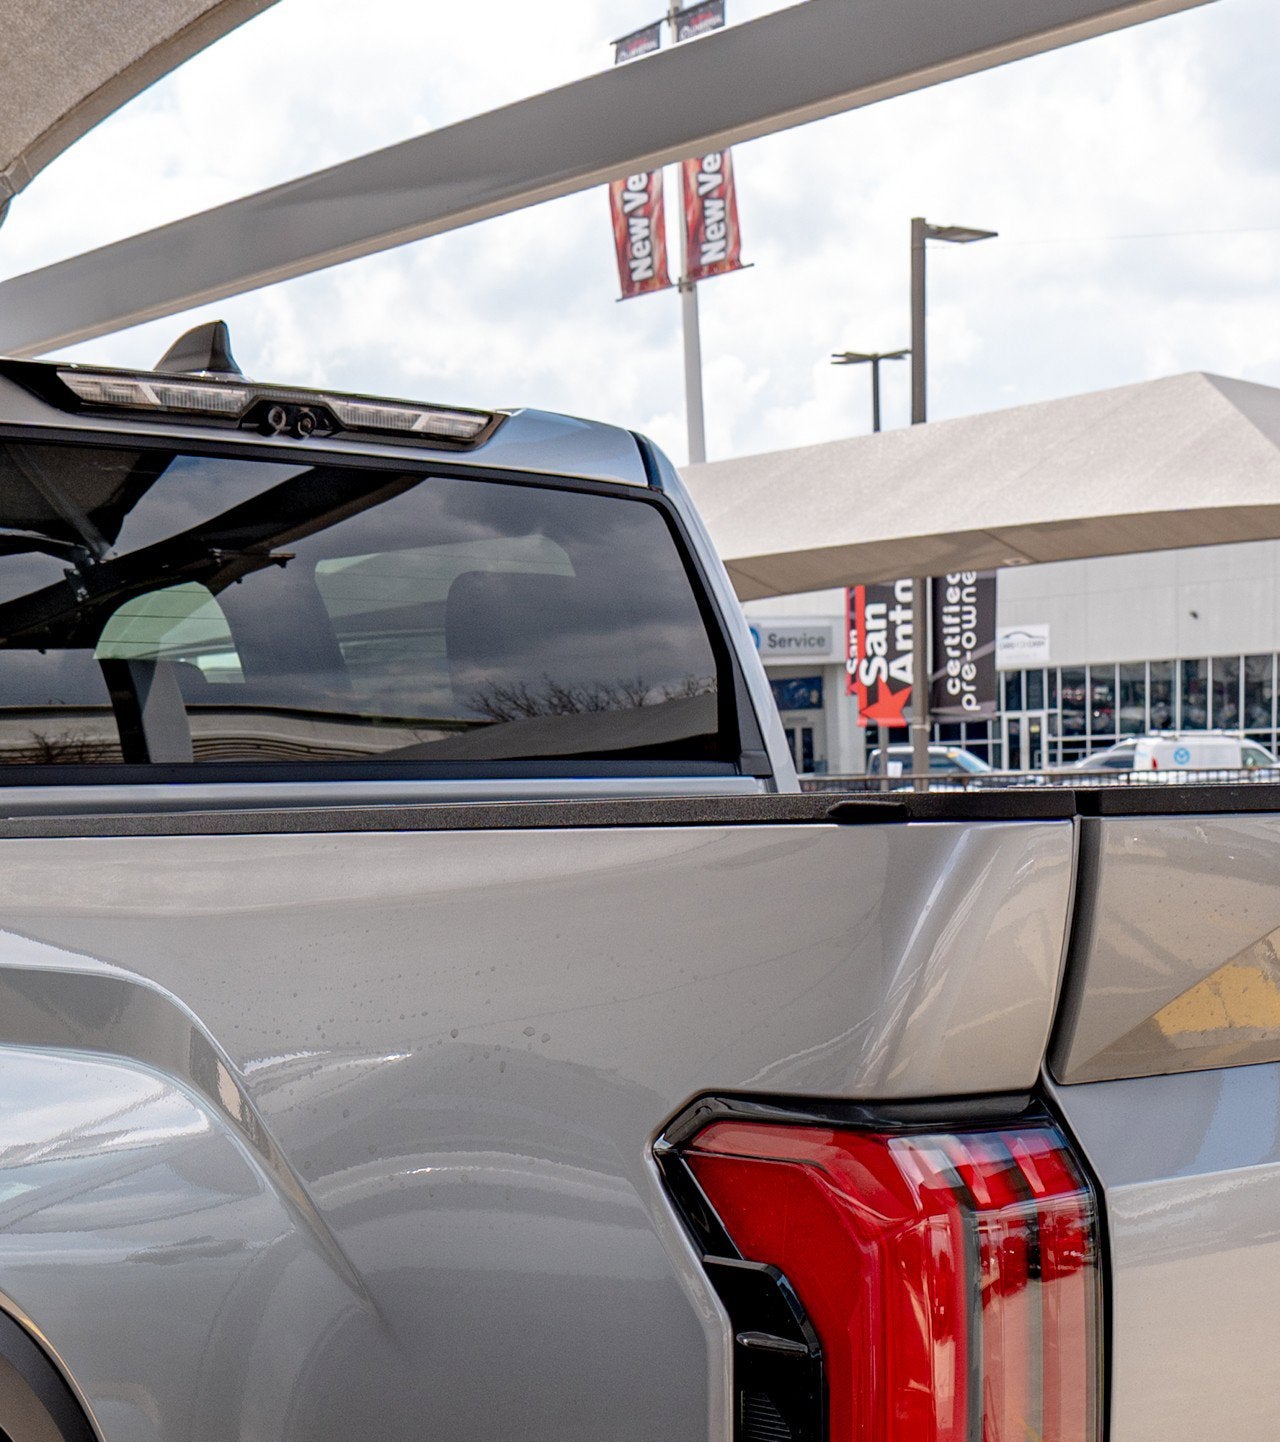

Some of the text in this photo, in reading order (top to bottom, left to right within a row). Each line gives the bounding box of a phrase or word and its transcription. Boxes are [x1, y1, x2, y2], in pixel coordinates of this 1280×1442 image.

[622, 172, 654, 282] New Ve
[697, 152, 726, 265] New Ve
[768, 632, 826, 649] Service
[859, 603, 887, 686] San
[888, 578, 913, 685] Anto
[961, 569, 981, 712] pre-owne
